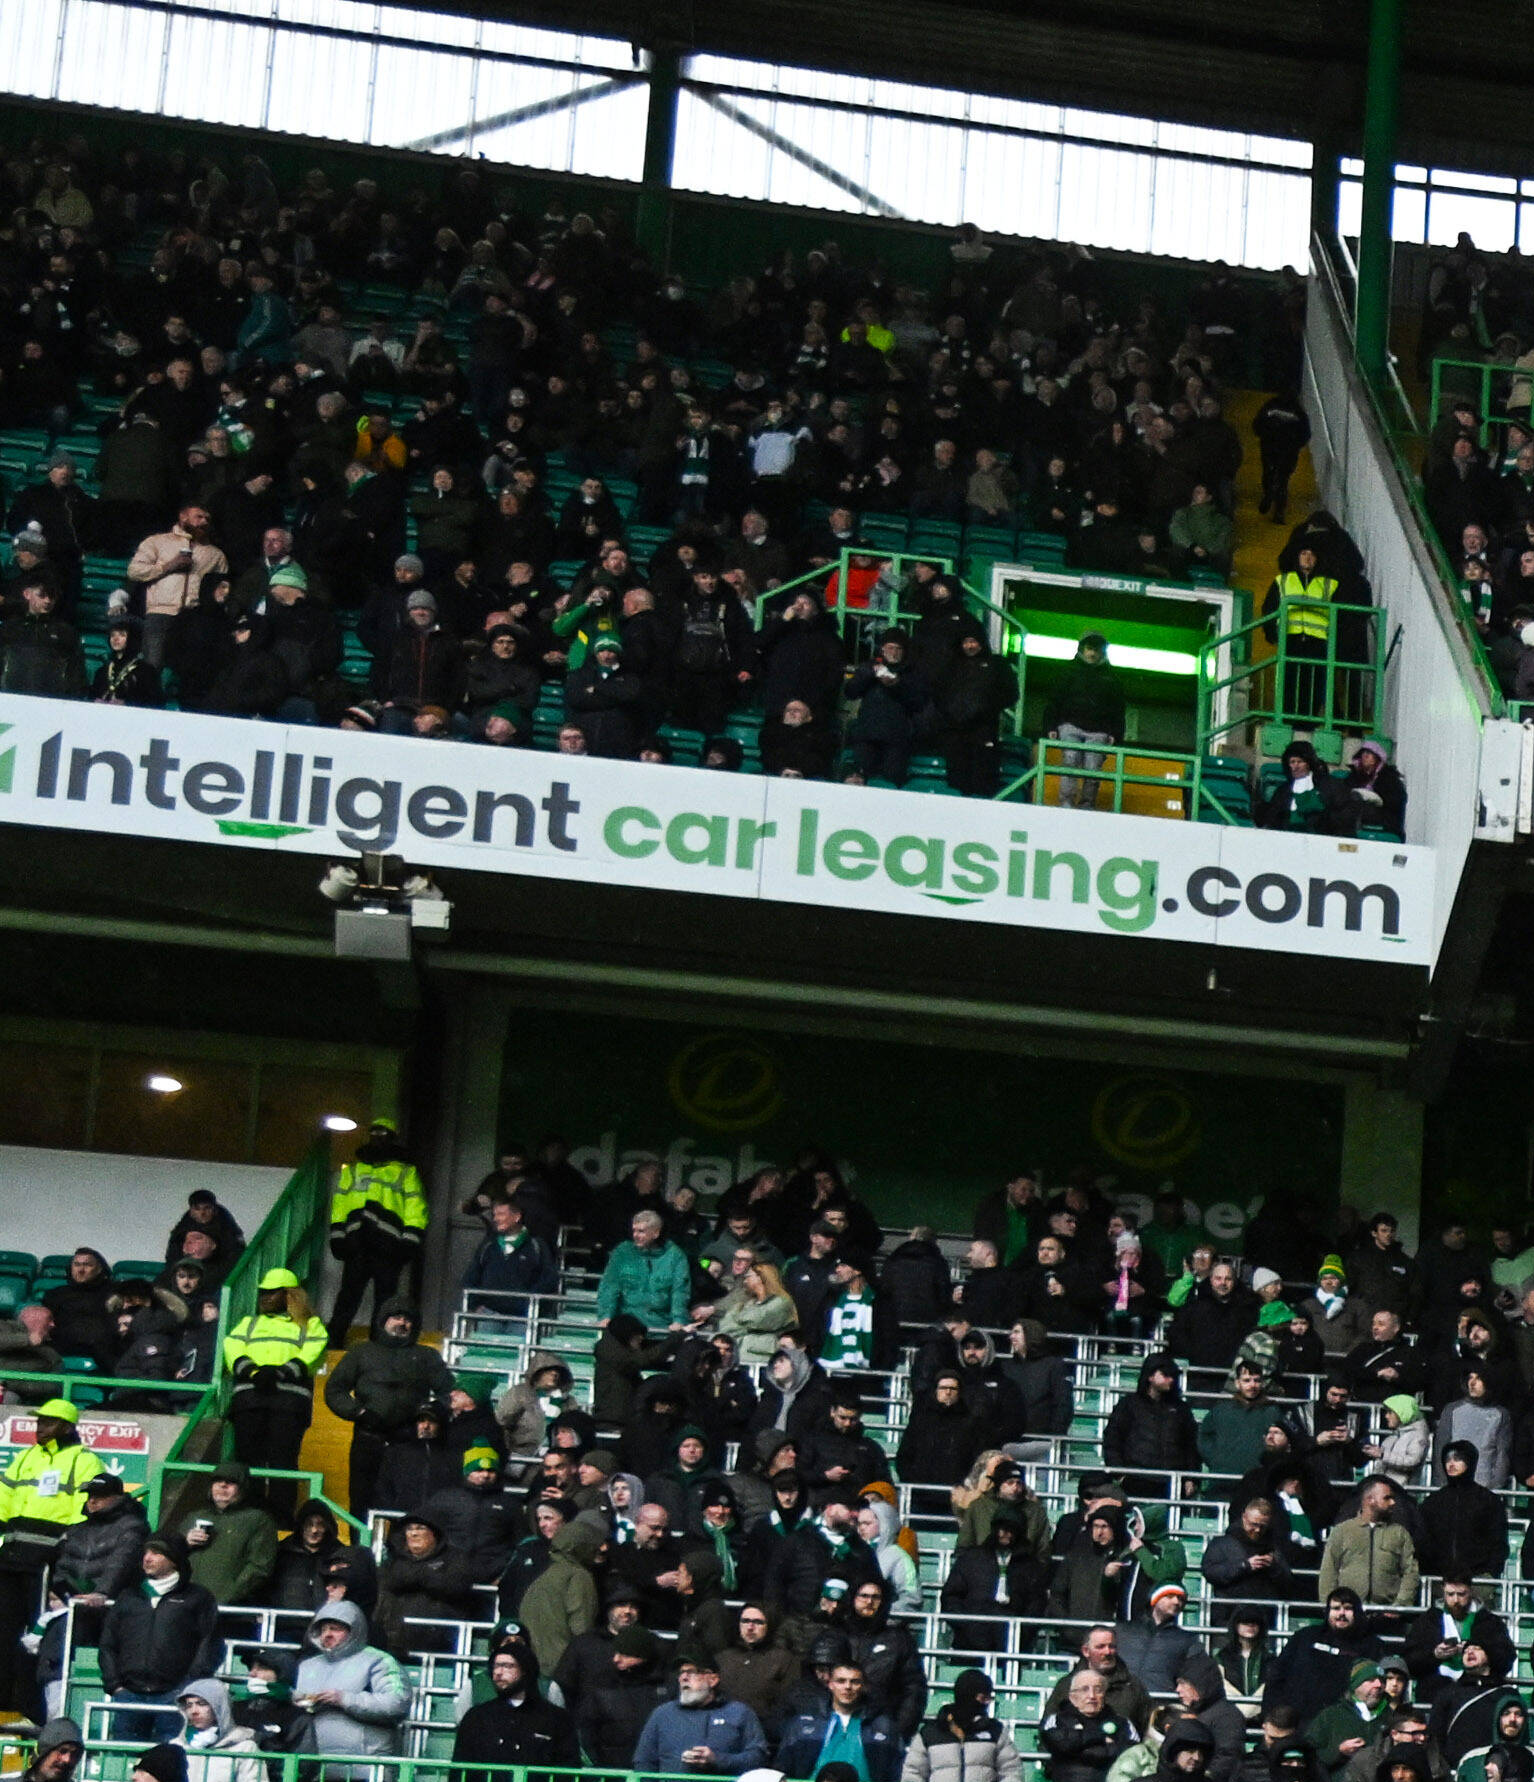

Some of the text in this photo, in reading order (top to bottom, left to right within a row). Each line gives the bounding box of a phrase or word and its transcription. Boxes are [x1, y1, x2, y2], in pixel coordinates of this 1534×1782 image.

[36, 729, 580, 852] Intelligent
[602, 804, 777, 872] car
[109, 1426, 141, 1438] EXIT
